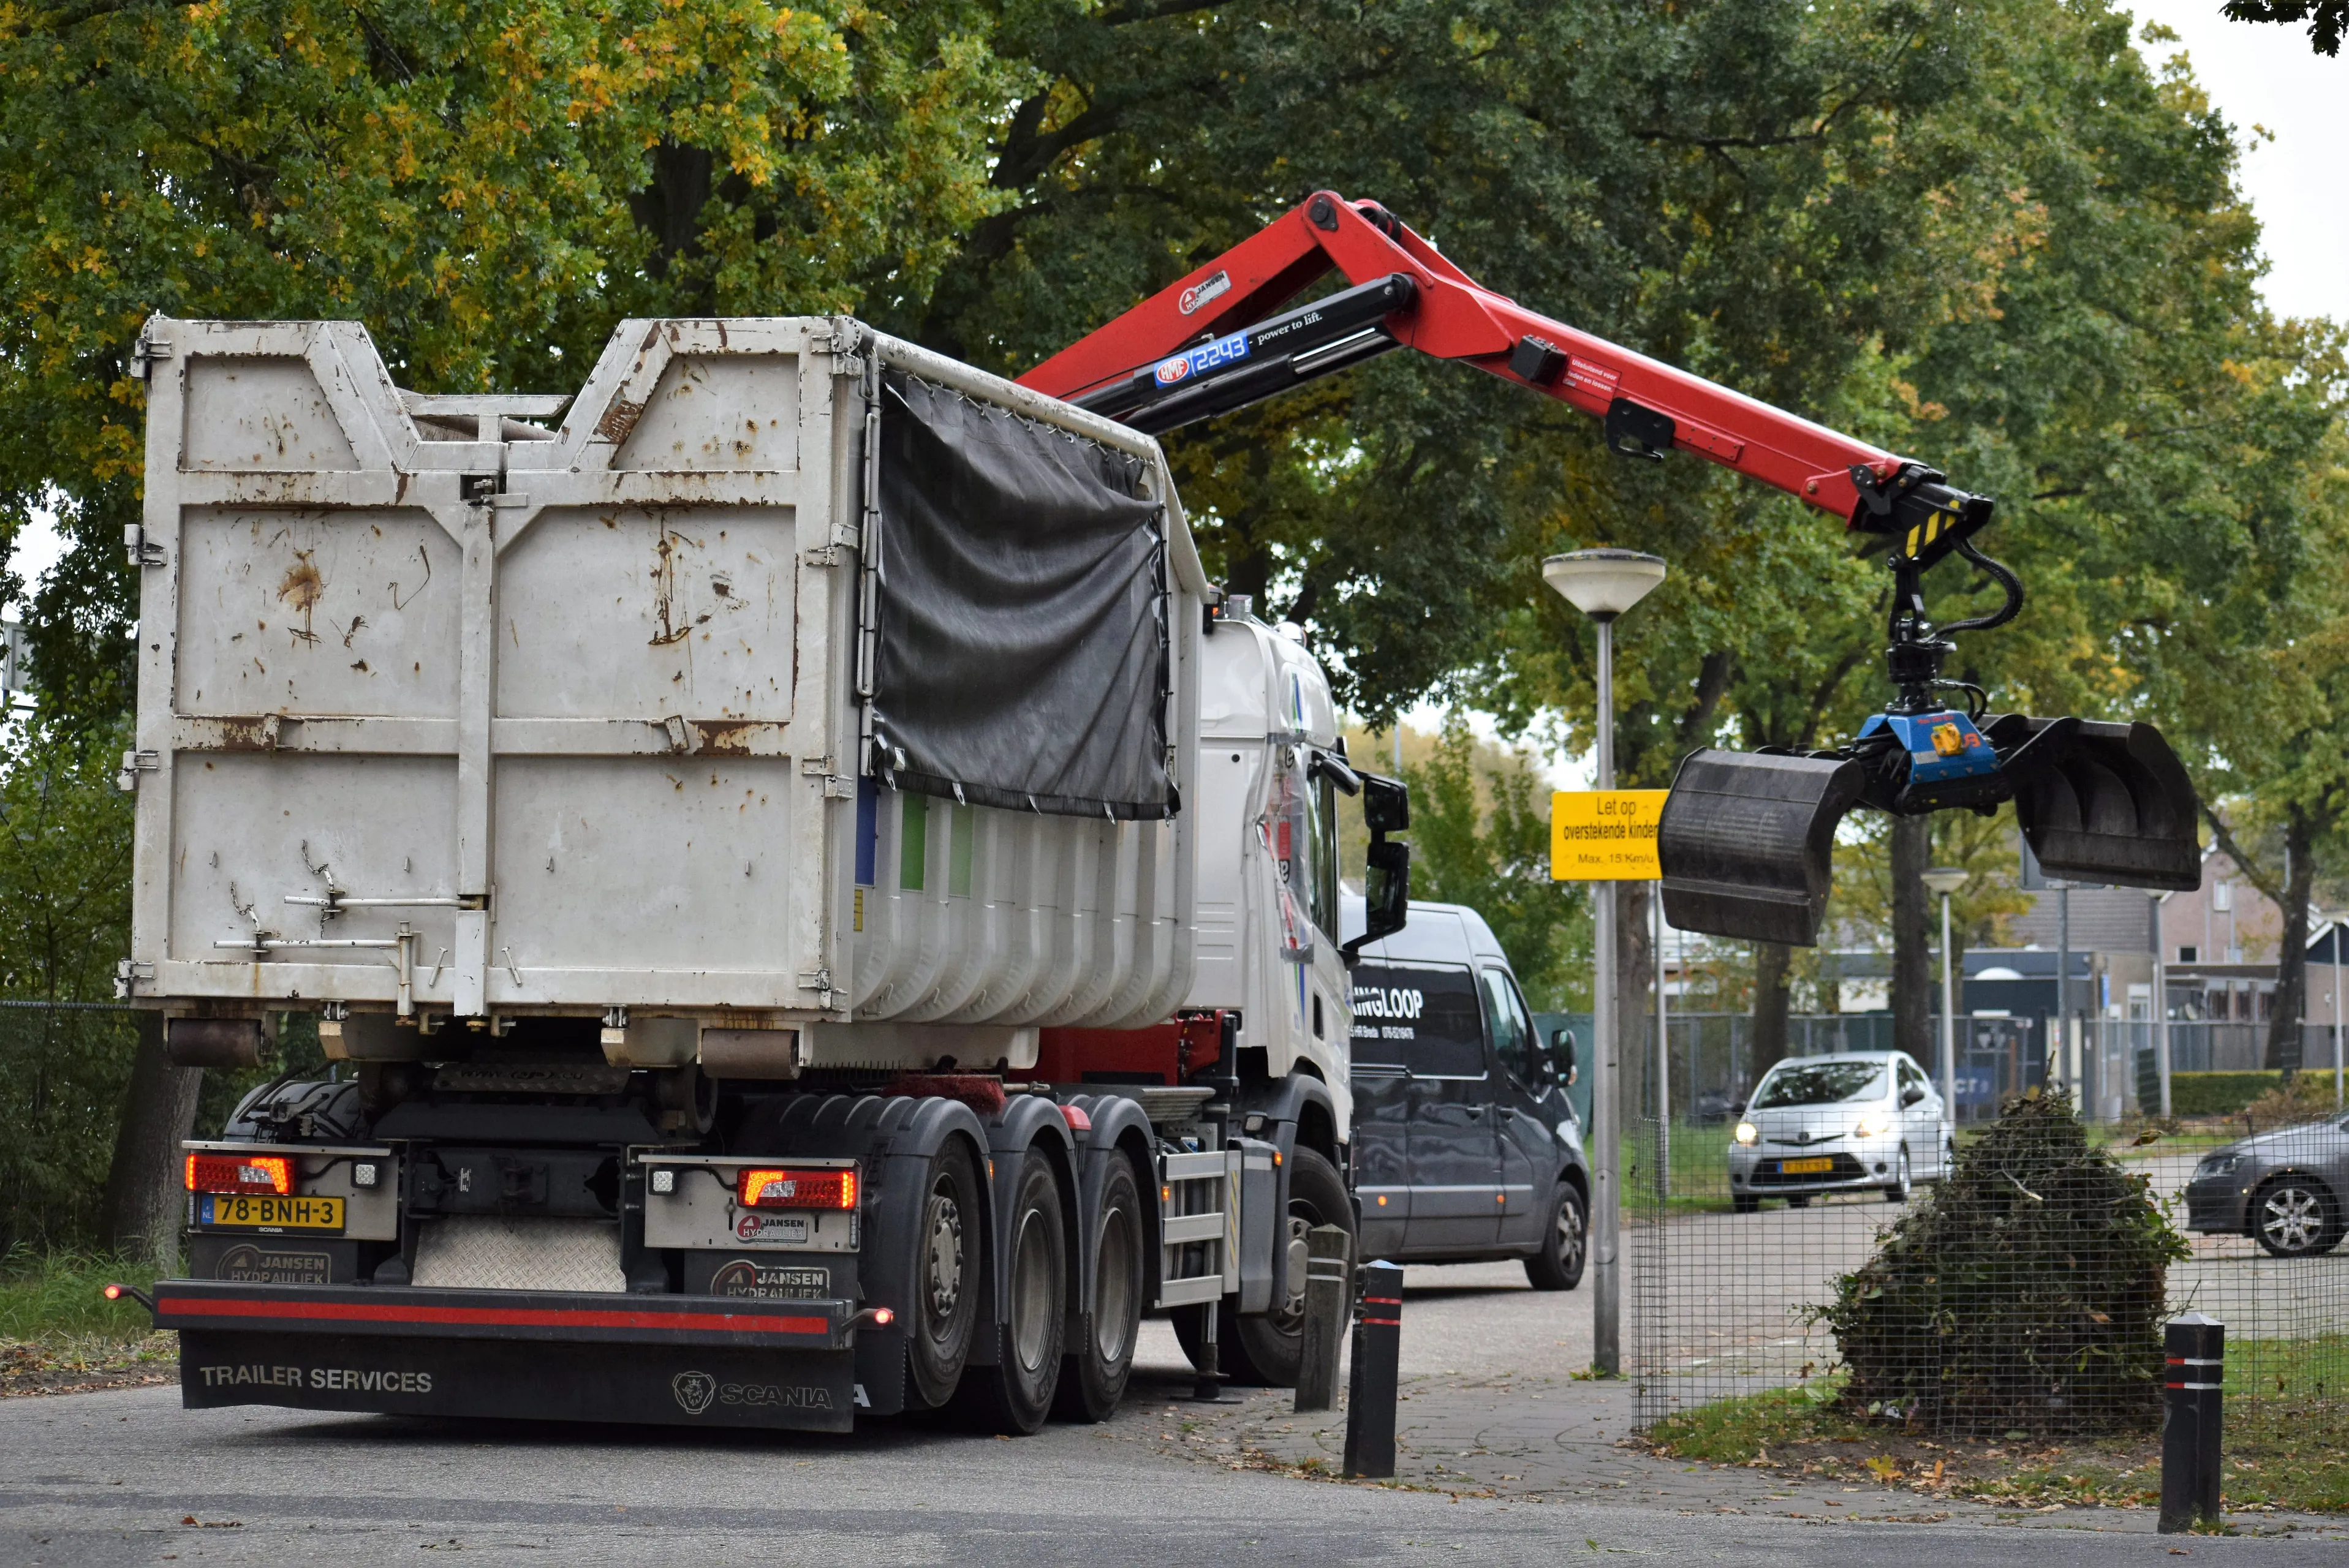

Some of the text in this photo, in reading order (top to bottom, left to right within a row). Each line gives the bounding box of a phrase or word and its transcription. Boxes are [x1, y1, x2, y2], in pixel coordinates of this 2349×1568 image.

[1160, 360, 1186, 380] HMF
[1257, 325, 1290, 345] power
[1291, 320, 1303, 331] to
[1304, 312, 1323, 326] lift.
[1603, 372, 1617, 380] voor
[1597, 797, 1636, 820] Let op
[1564, 820, 1625, 840] overstekende
[1610, 854, 1622, 864] 15
[1625, 853, 1654, 864] Km/u
[1352, 986, 1423, 1019] INGLOOP
[220, 1198, 334, 1224] 78-BNH-3
[743, 1229, 803, 1237] HYDRAULIEK
[762, 1219, 804, 1227] JANSEN
[260, 1256, 325, 1270] JANSEN
[757, 1272, 823, 1286] JANSEN
[200, 1365, 433, 1393] TRAILER SERVICES
[720, 1384, 833, 1409] SCANIA
